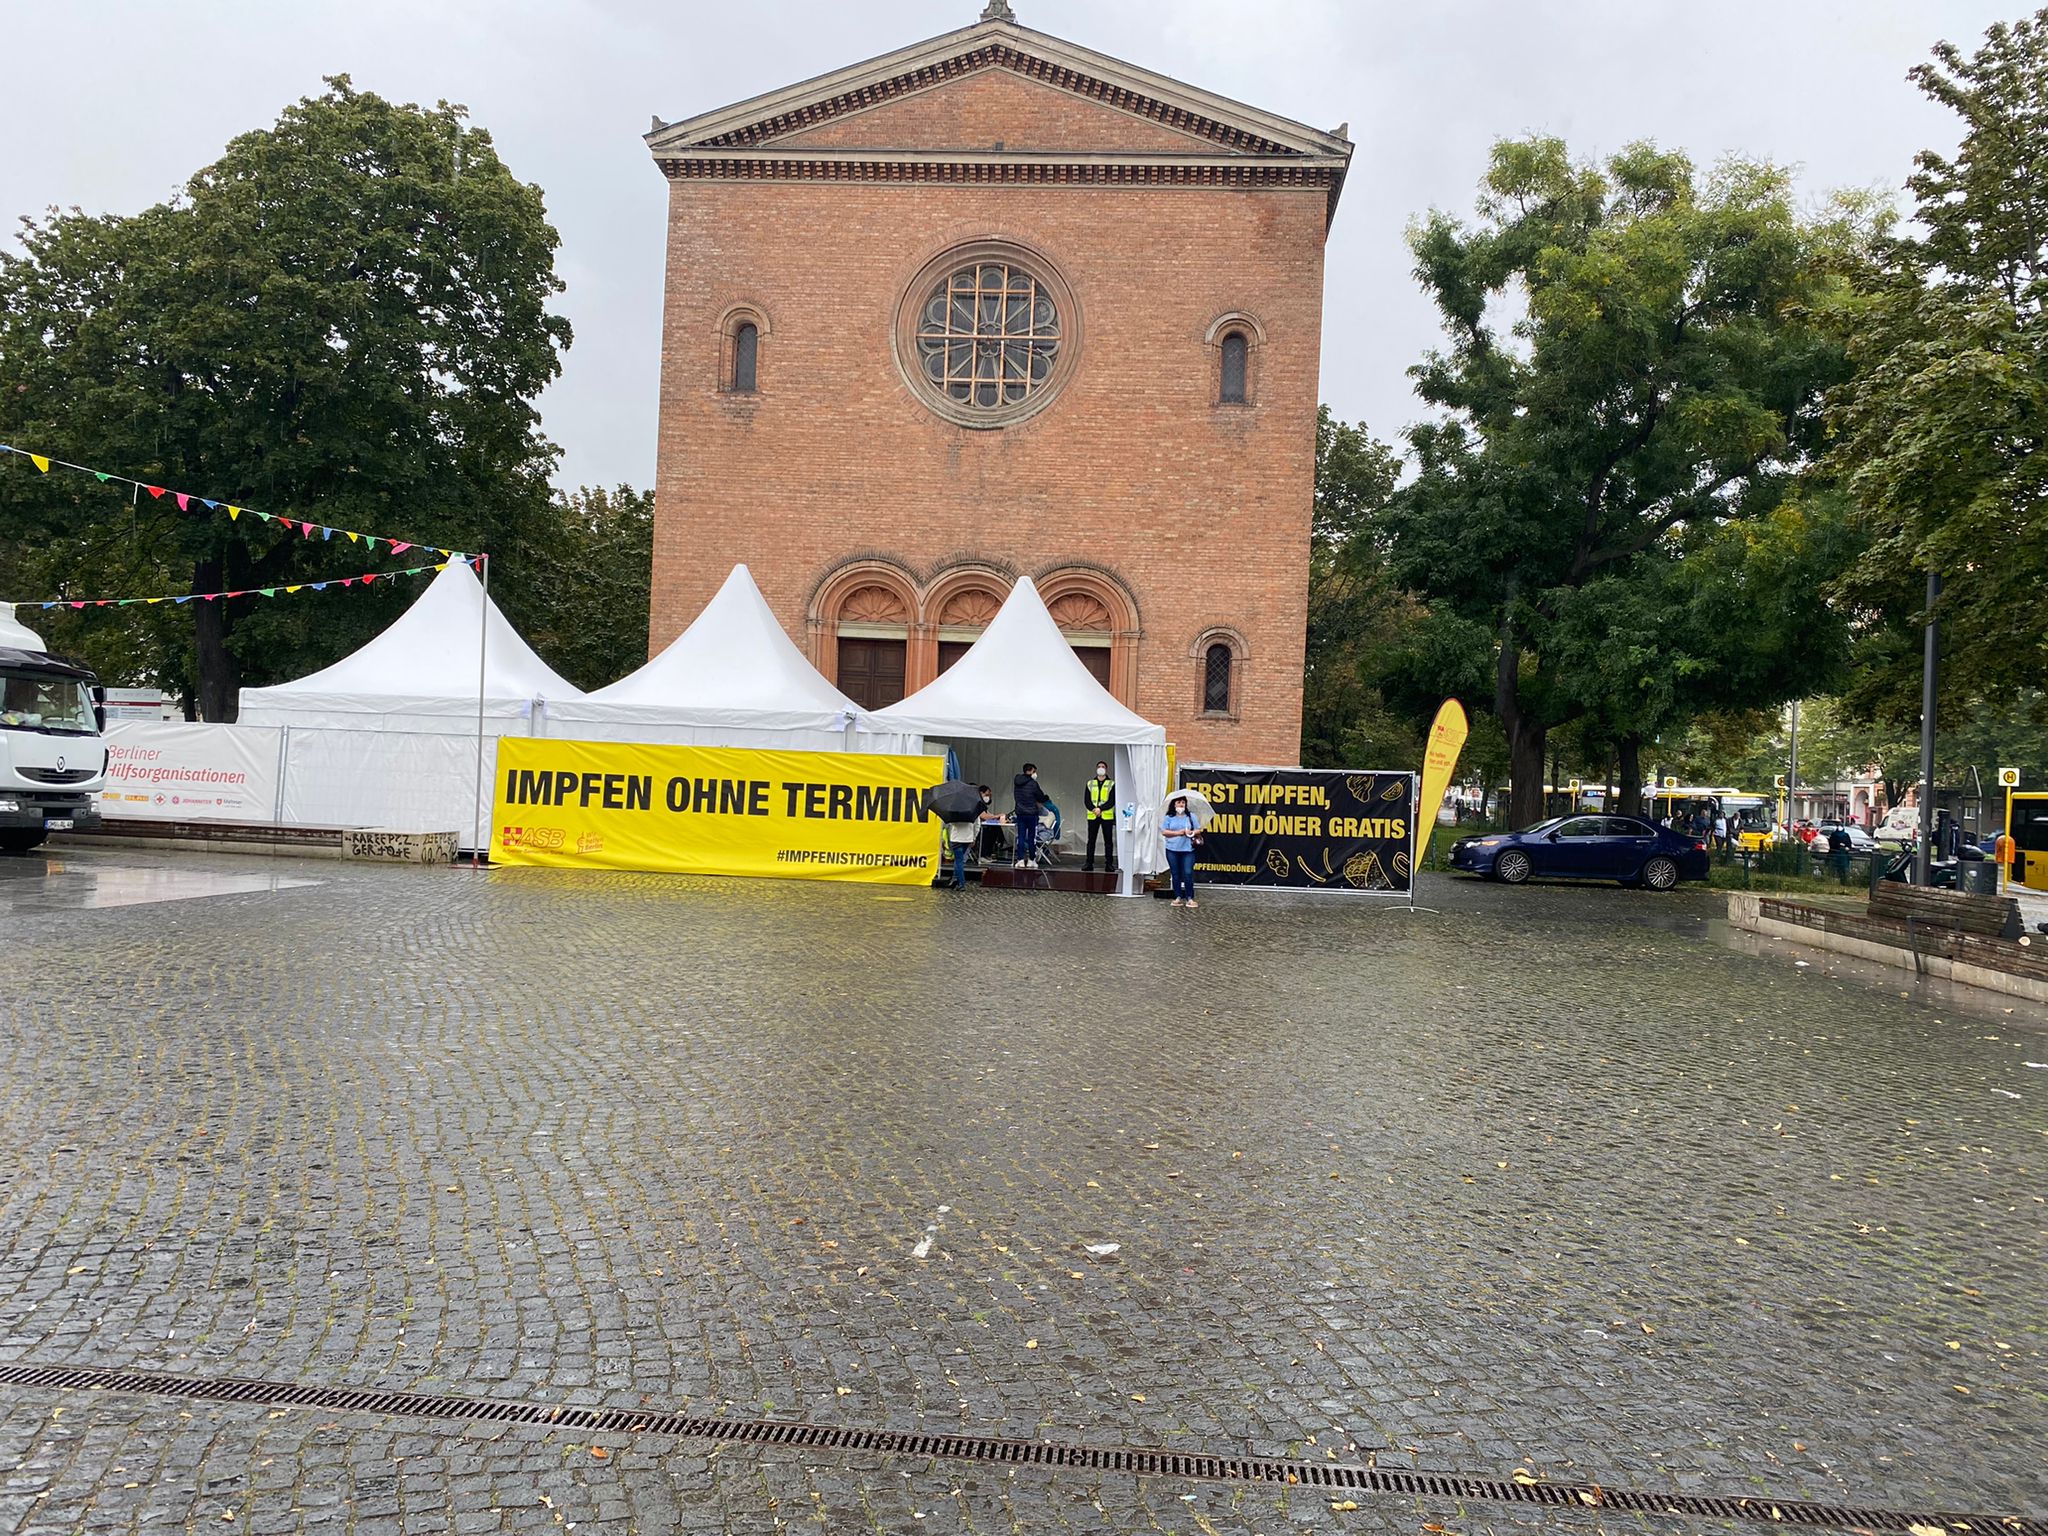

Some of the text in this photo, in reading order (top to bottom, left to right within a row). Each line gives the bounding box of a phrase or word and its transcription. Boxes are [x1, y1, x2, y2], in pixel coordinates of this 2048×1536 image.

[109, 745, 162, 761] Berliner
[109, 763, 246, 784] Hilfsorganisationen
[506, 769, 931, 823] IMPFEN OHNE TERMIN
[1244, 784, 1331, 811] IMPFEN,
[1201, 810, 1406, 840] ANN DÖNER GRATIS
[520, 827, 567, 849] ASB
[777, 849, 928, 868] #IMPFENISTHOFFNUNG
